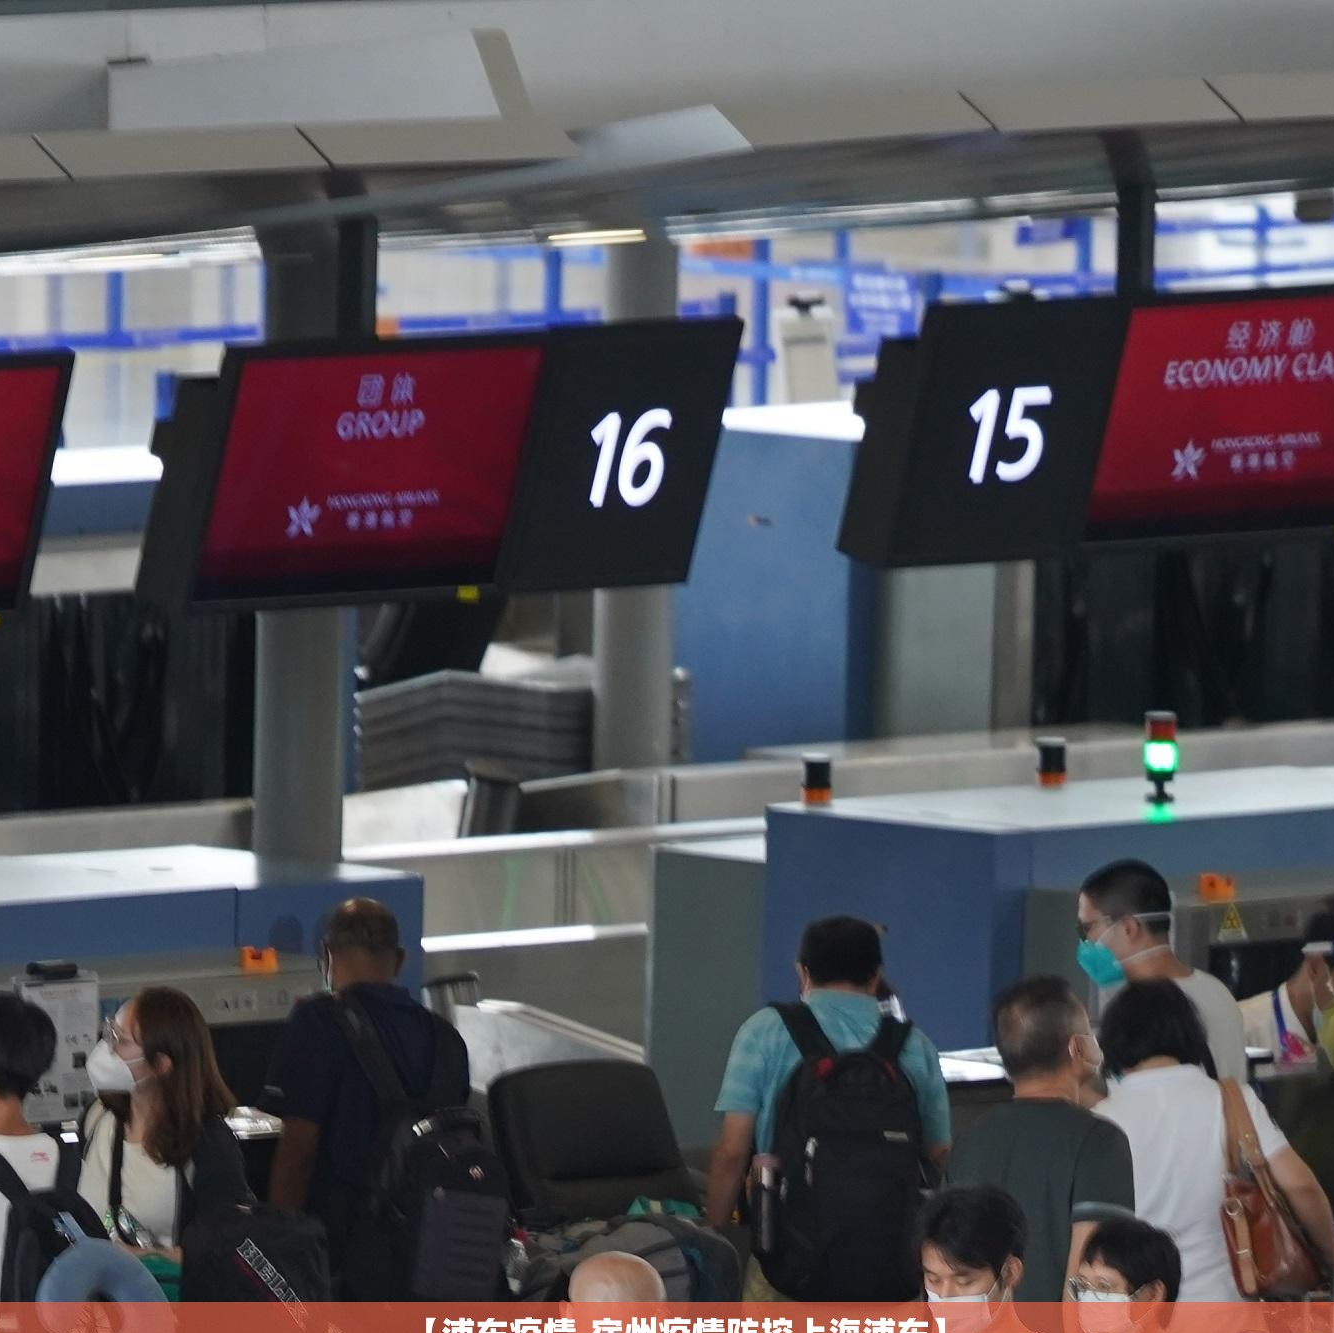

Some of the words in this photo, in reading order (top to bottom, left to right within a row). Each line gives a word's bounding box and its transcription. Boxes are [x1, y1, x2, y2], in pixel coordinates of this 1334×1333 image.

[1227, 318, 1315, 351] 经济舱
[1164, 353, 1287, 389] ECONOMY
[336, 408, 425, 440] GROUP
[968, 385, 1052, 484] 15
[589, 408, 673, 508] 16
